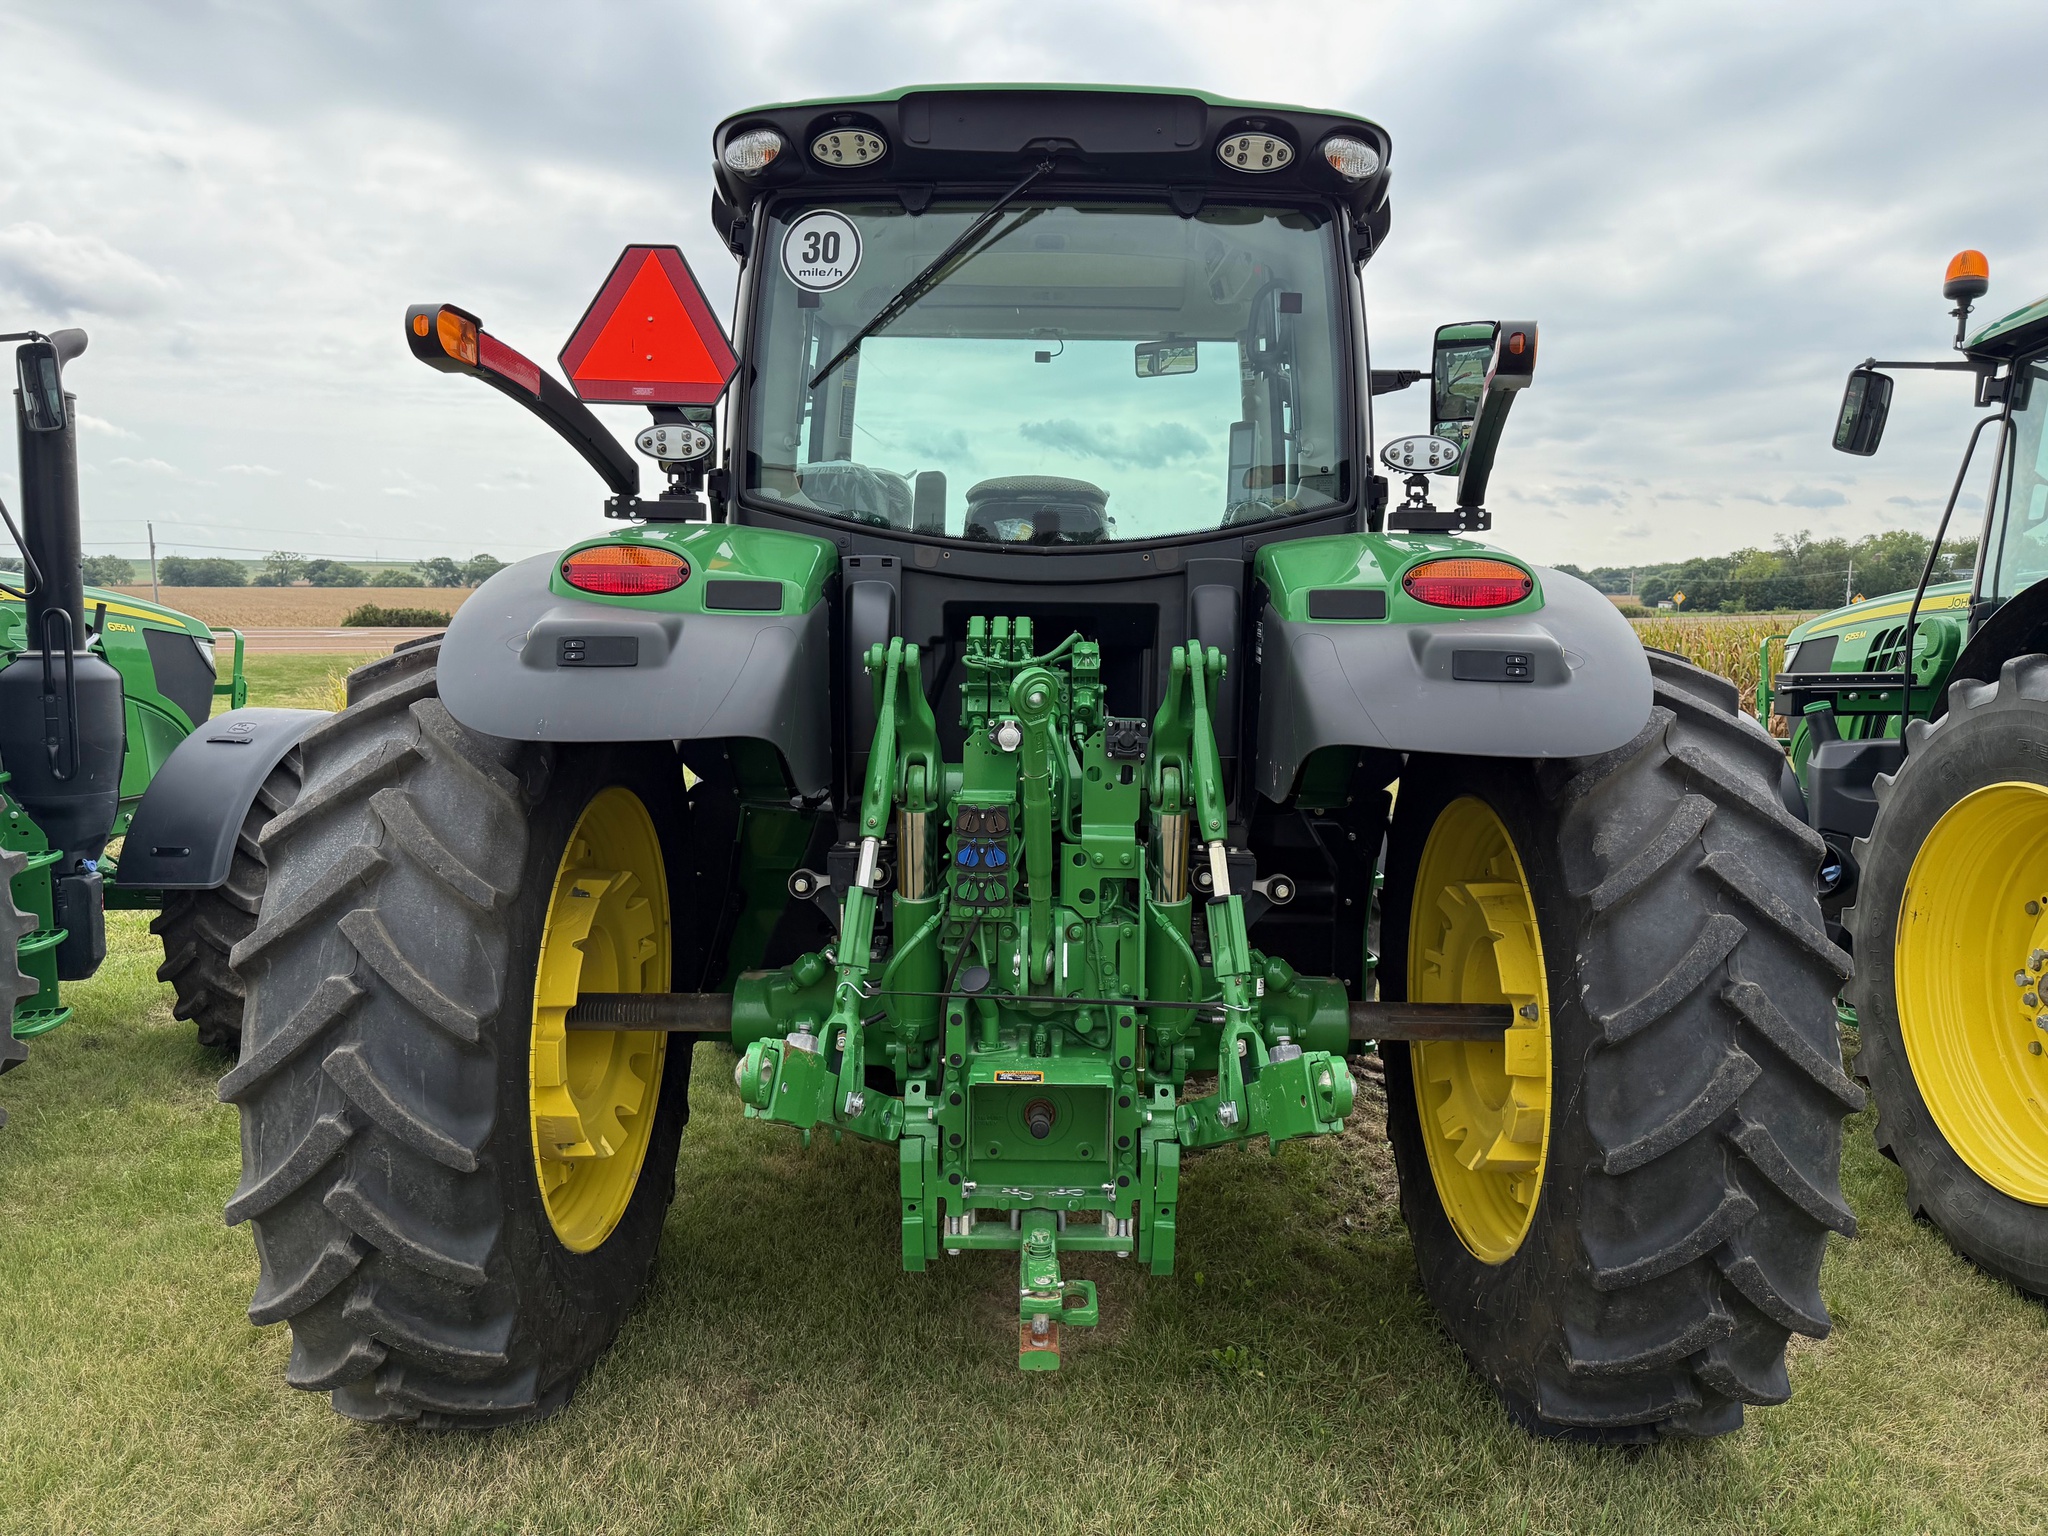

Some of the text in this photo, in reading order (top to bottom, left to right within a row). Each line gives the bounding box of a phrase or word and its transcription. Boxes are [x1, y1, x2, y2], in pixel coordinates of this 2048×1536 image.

[802, 231, 840, 264] 30
[799, 267, 843, 277] mile/h
[1948, 597, 1969, 609] JOH
